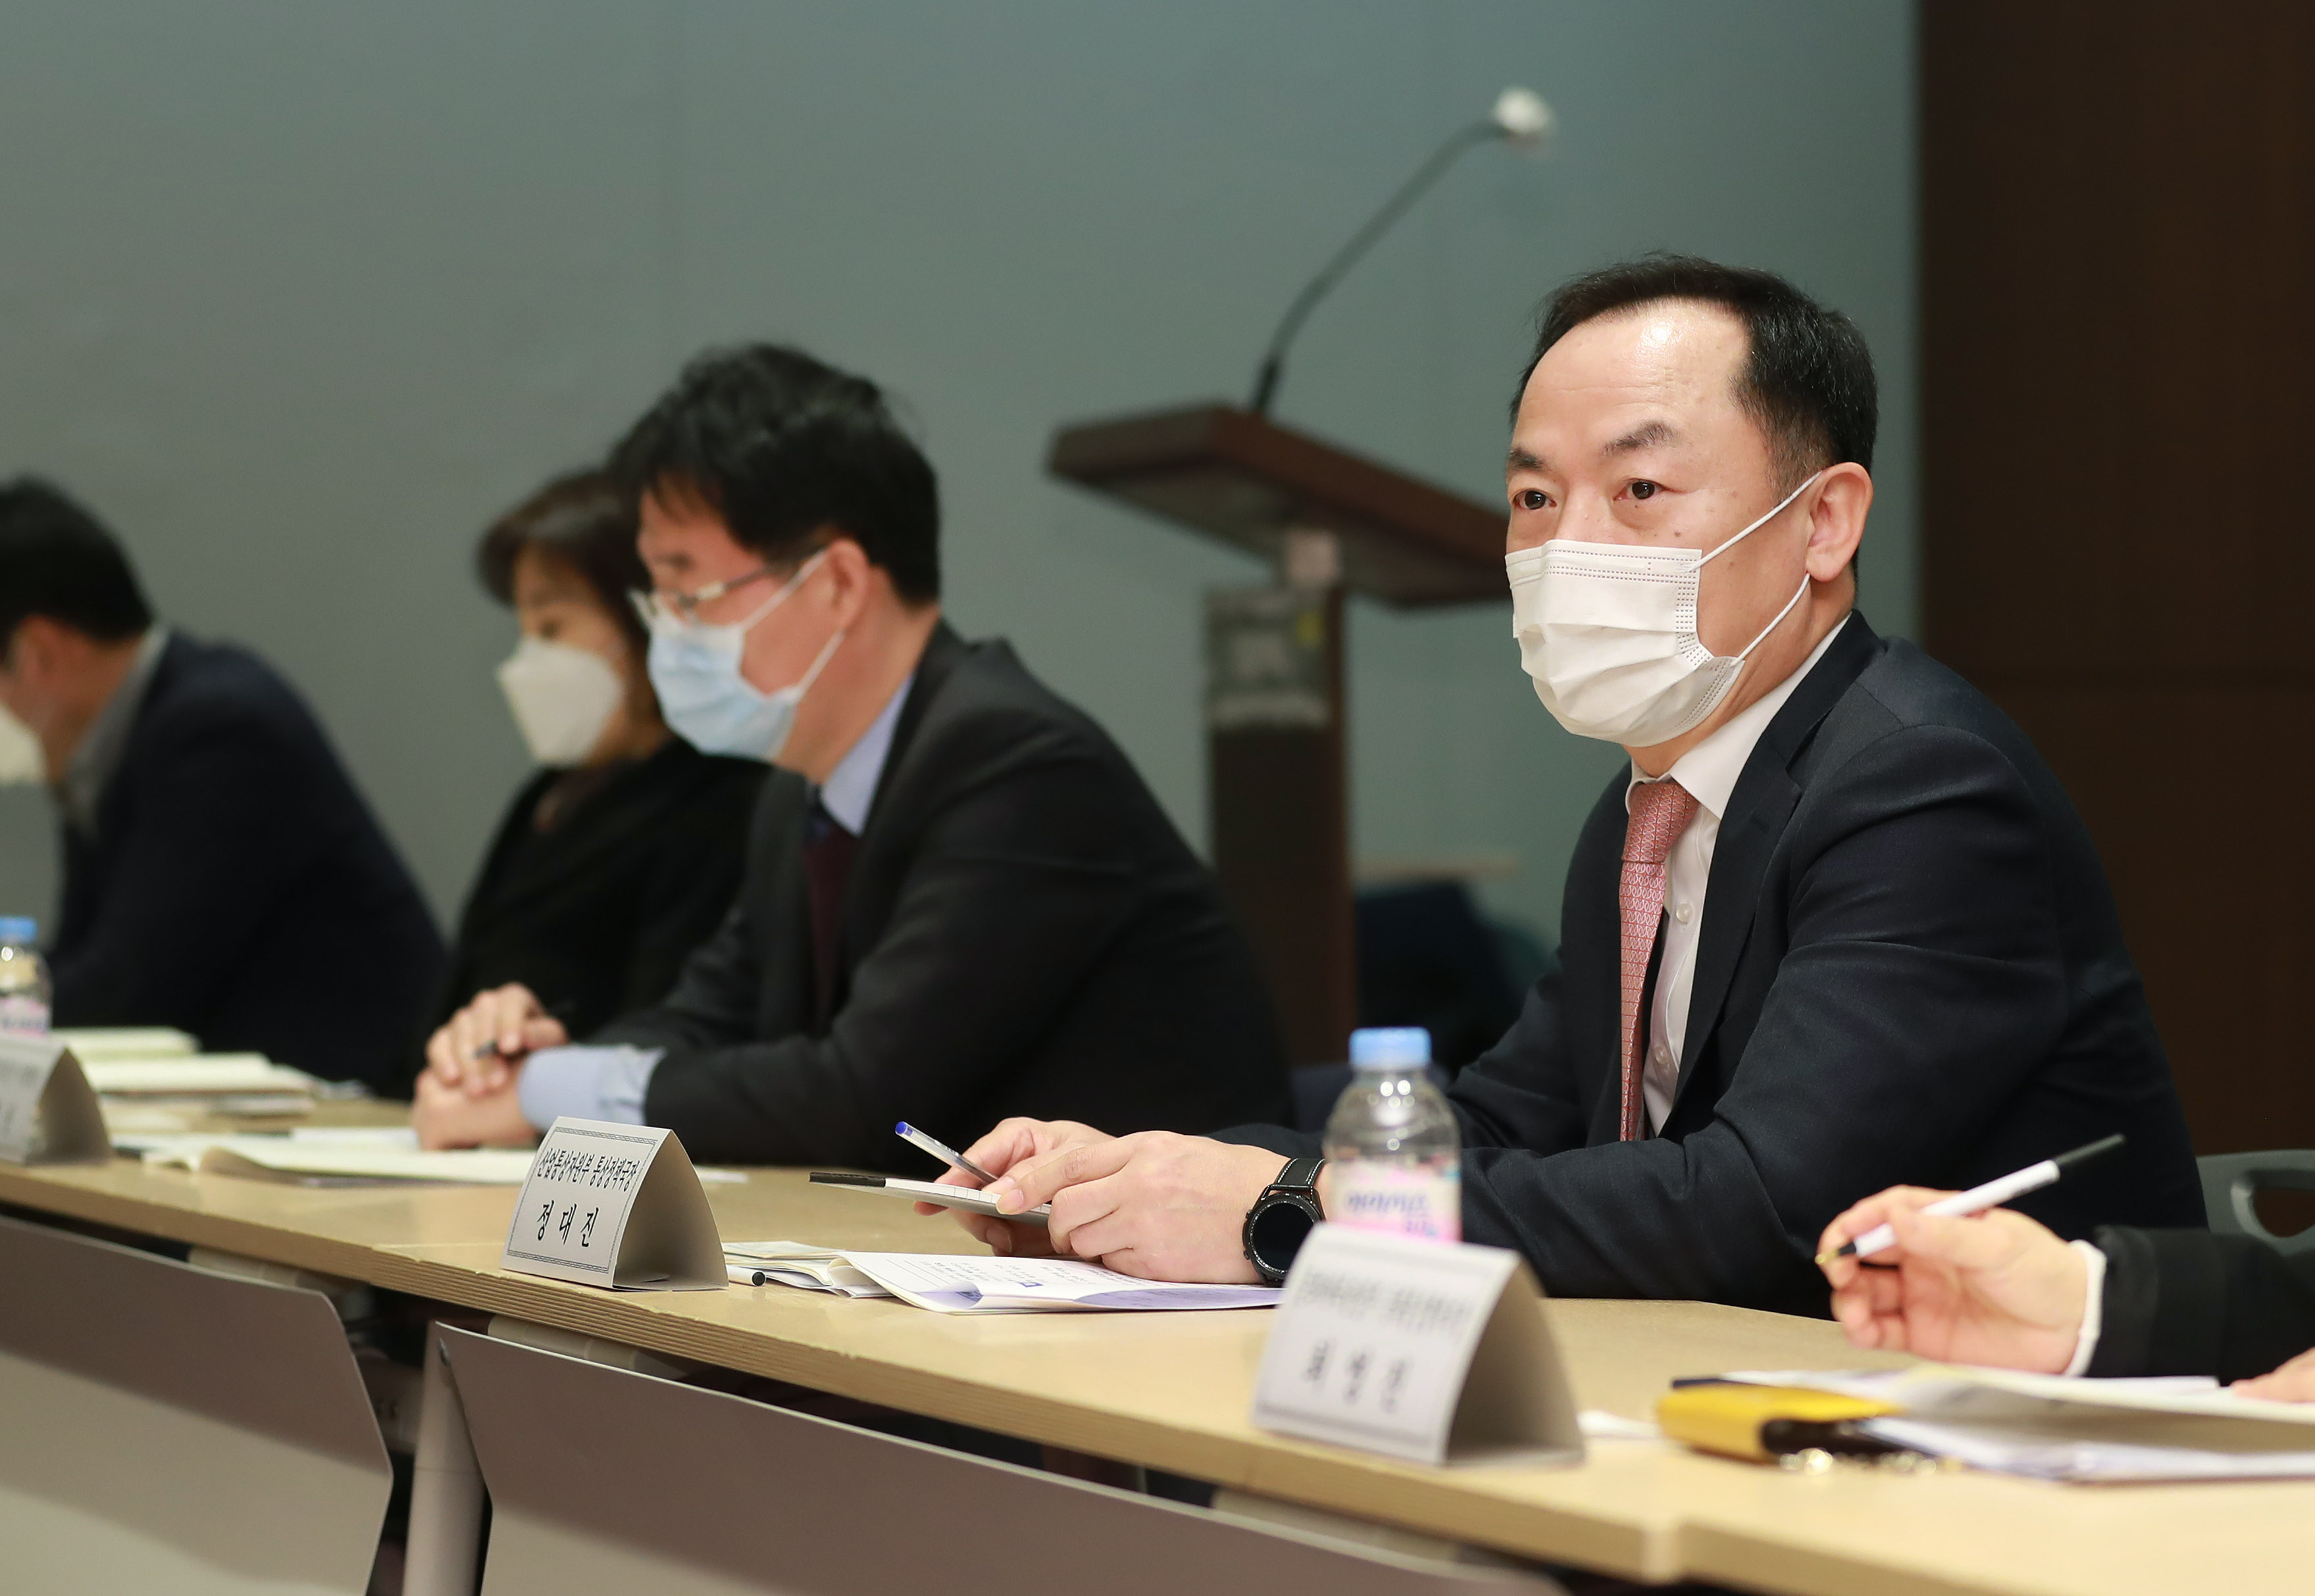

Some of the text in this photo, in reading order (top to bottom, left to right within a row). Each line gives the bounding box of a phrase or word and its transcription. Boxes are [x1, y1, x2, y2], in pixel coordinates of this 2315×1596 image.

[537, 1147, 640, 1192] 산업통상자원부 통상정책국장
[537, 1199, 599, 1247] 정 대 진
